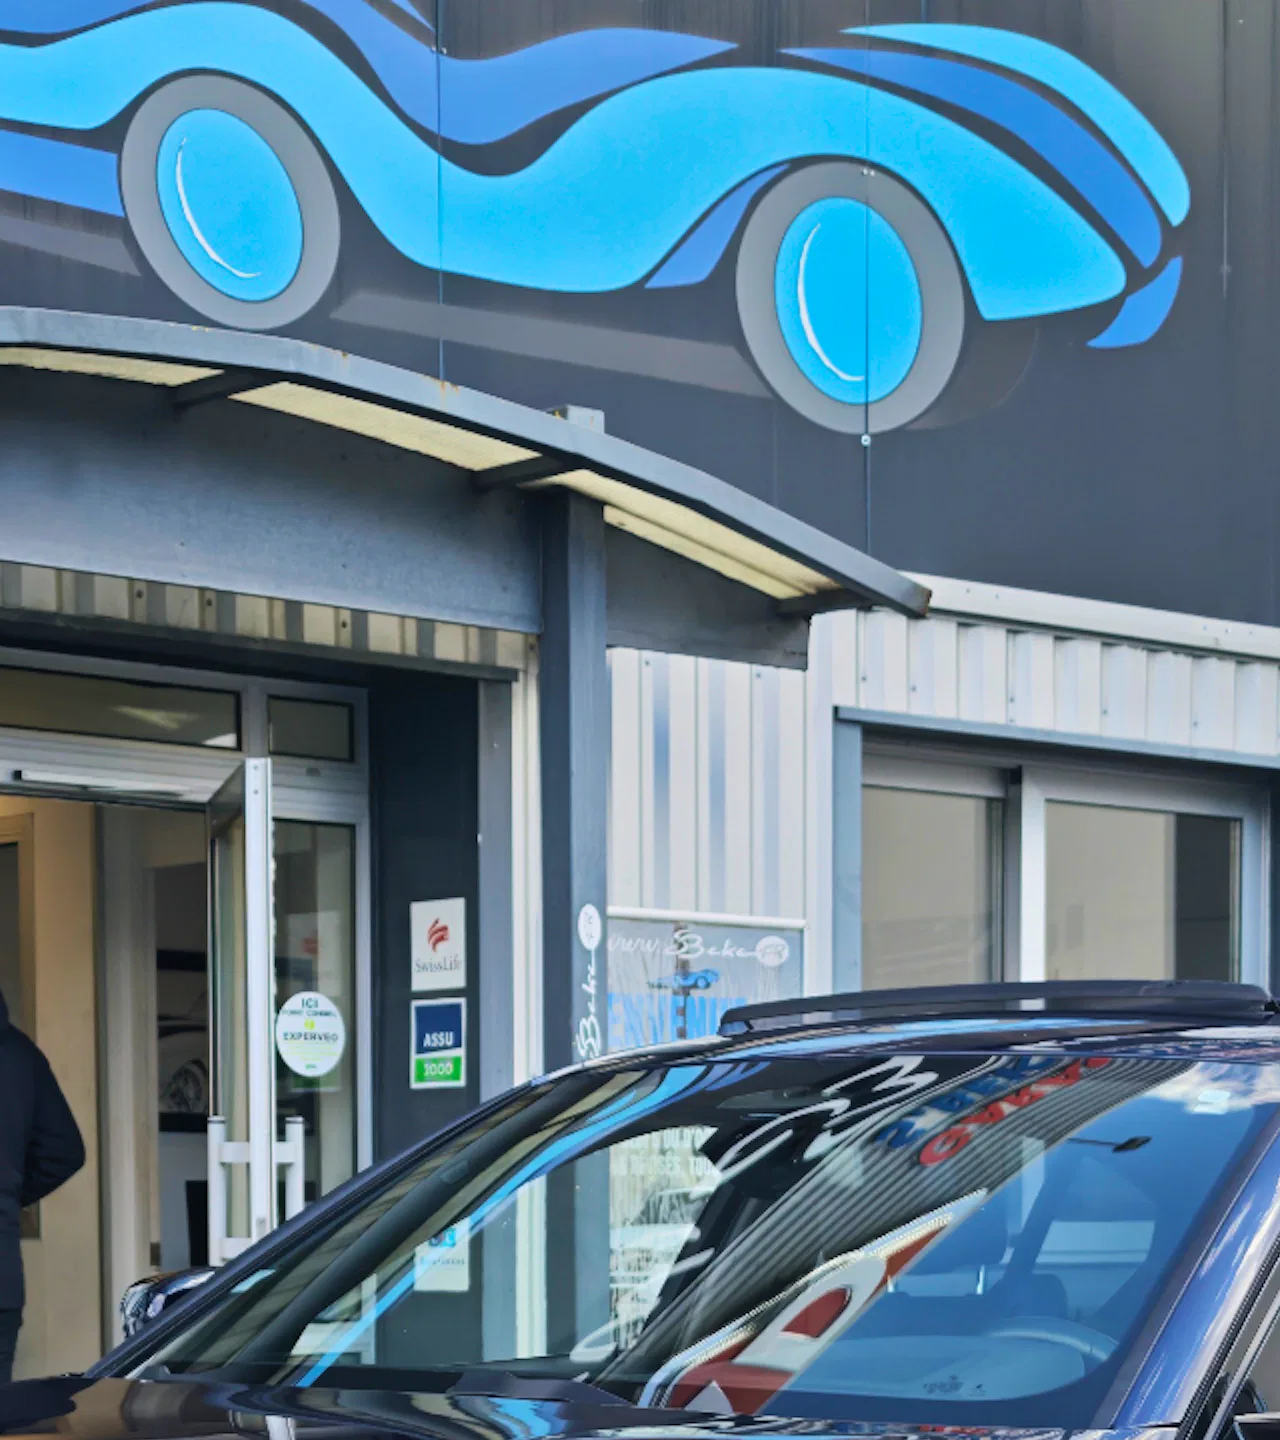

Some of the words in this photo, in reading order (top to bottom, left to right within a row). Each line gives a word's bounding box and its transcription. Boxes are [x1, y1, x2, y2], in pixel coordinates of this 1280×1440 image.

[301, 997, 319, 1009] ICI
[423, 1031, 455, 1048] ASSU
[423, 1060, 454, 1077] 2000
